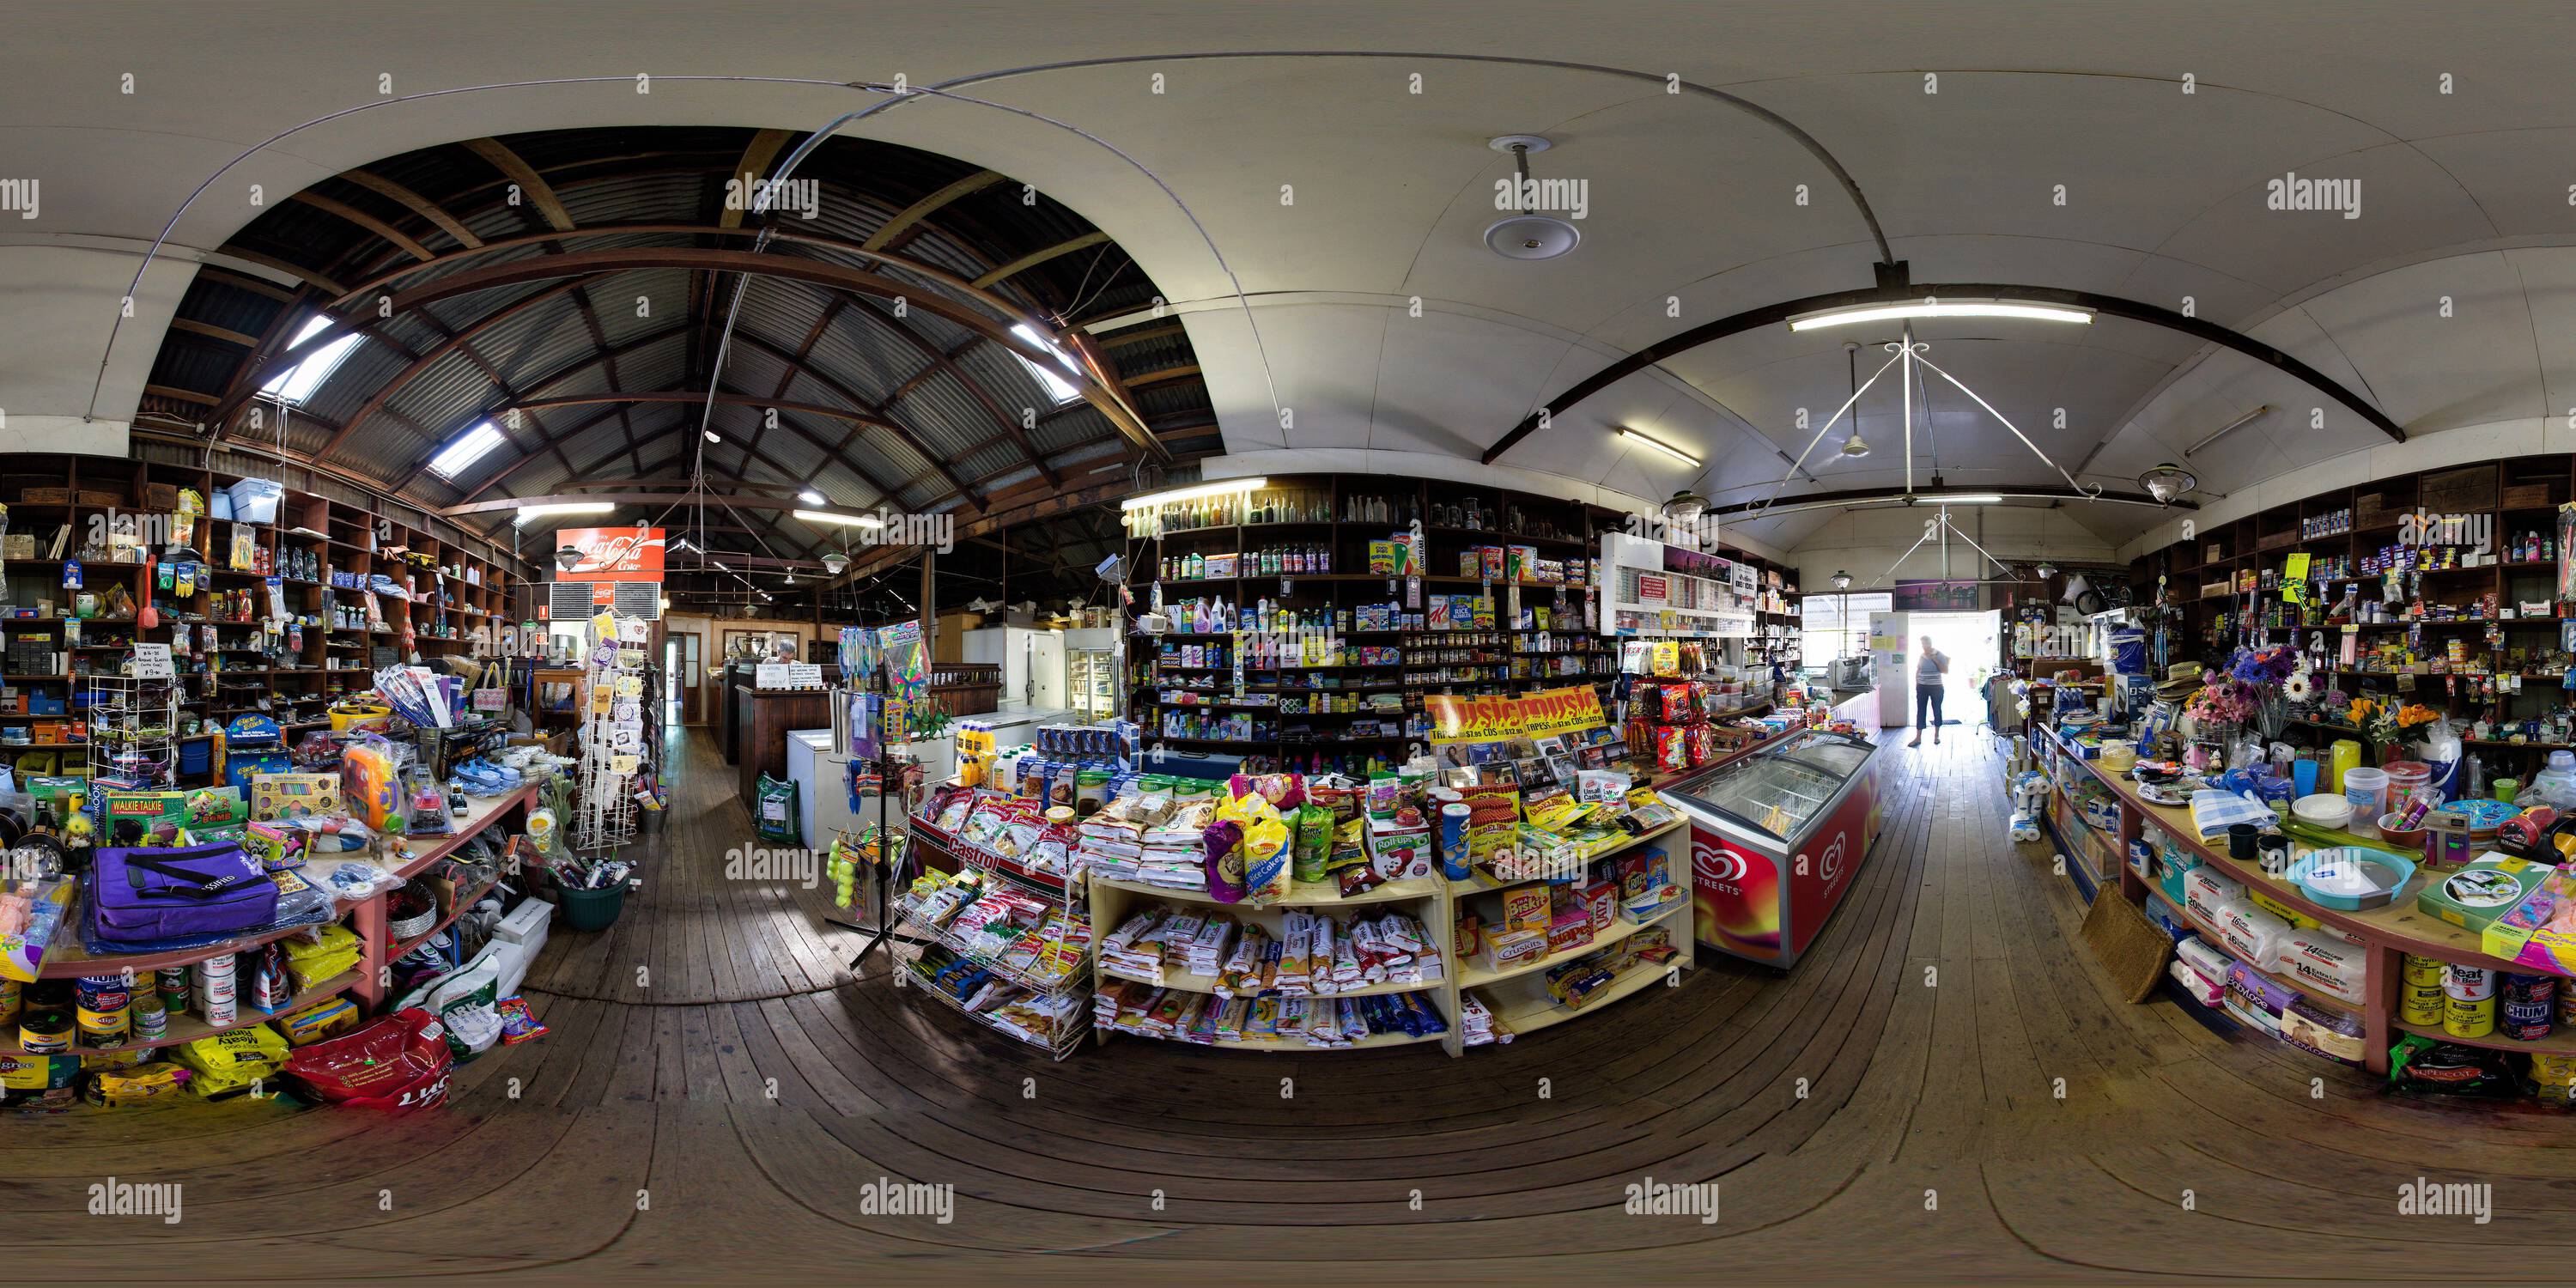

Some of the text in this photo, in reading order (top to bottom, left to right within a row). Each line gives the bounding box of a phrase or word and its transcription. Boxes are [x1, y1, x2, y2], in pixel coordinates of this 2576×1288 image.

[1517, 688, 1597, 721] music
[1571, 717, 1583, 726] CDS
[1484, 727, 1498, 737] CDS
[112, 800, 162, 811] WALKIE TALKIE
[948, 837, 998, 871] Castrol
[1249, 871, 1263, 884] Rice
[1261, 854, 1283, 875] Cakes
[1629, 877, 1644, 890] RITZ
[1692, 874, 1740, 896] STREETS
[1823, 868, 1844, 898] STREETS
[1508, 896, 1548, 915] Biskit
[1626, 890, 1659, 907] Premium
[2232, 915, 2240, 926] 16
[2227, 933, 2237, 945] 16
[1503, 939, 1542, 958] Cruskits
[2305, 945, 2317, 954] 14
[2296, 962, 2312, 975] 14
[2450, 963, 2483, 978] Meat
[2506, 1003, 2549, 1017] CHUM
